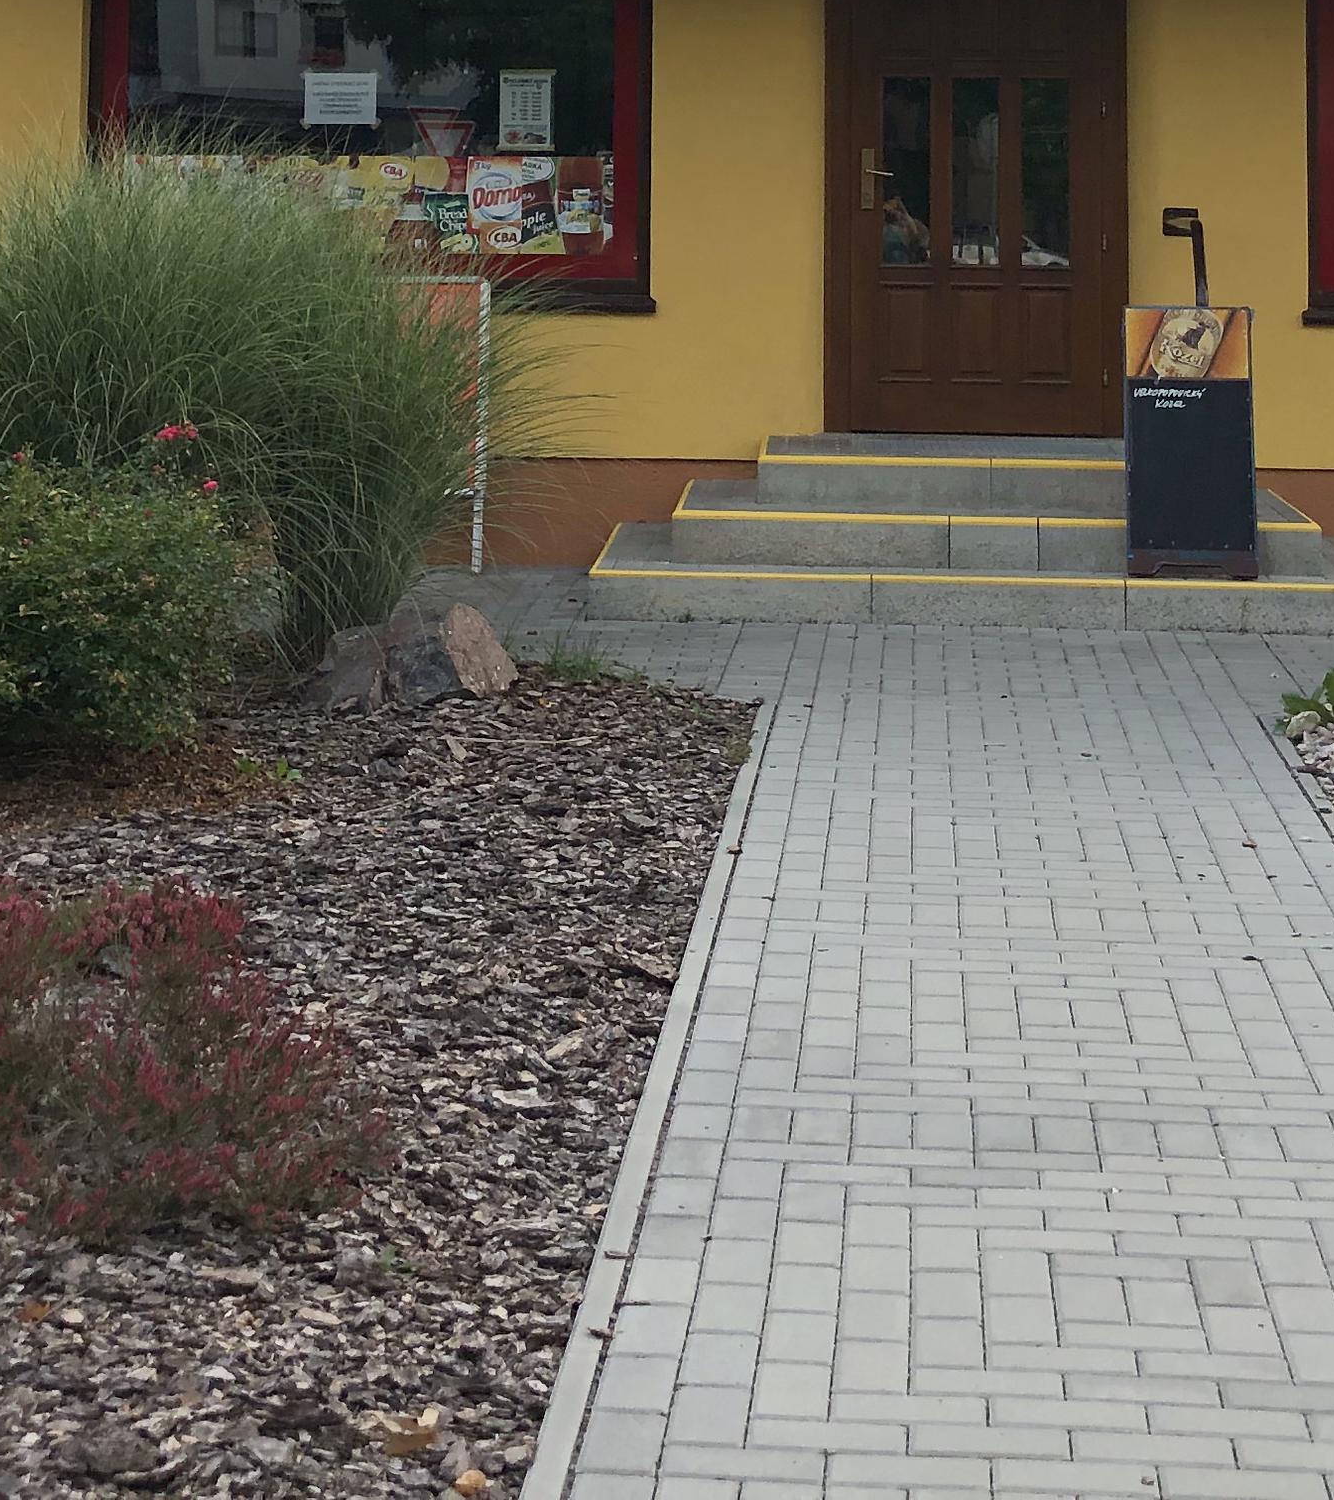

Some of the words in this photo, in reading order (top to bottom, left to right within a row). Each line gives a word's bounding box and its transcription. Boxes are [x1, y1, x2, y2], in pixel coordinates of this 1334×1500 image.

[383, 165, 403, 177] CBA
[438, 207, 468, 220] Bread
[493, 232, 518, 243] CBA
[1159, 338, 1205, 367] Kozel
